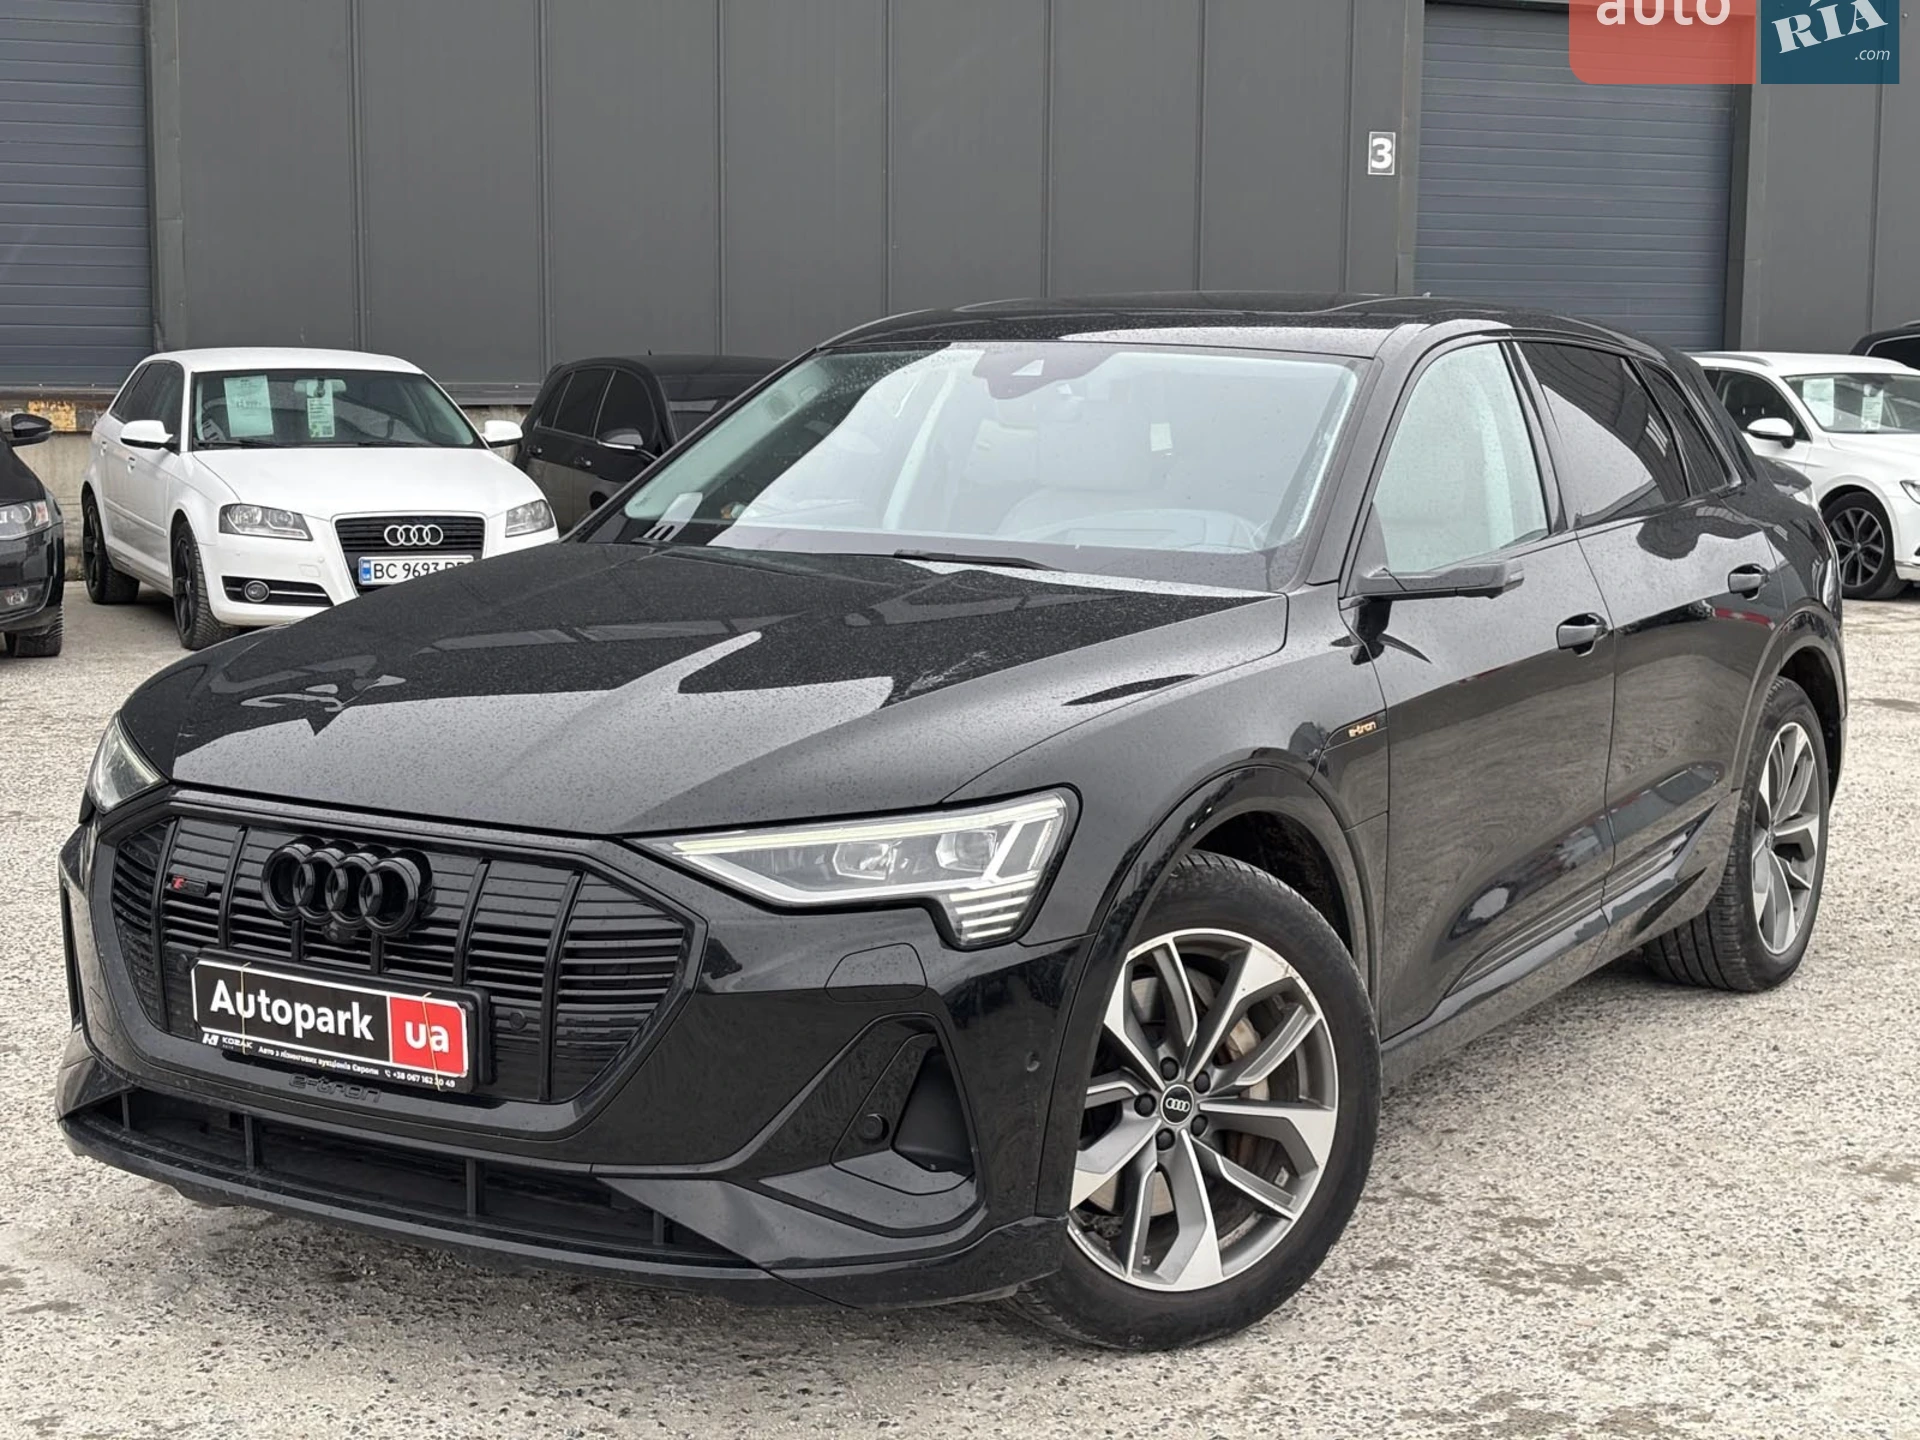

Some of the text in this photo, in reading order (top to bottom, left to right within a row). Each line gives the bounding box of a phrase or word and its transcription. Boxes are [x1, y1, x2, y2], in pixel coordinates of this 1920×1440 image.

[1371, 137, 1393, 169] 3
[373, 563, 398, 579] BC
[1348, 721, 1377, 738] e-tron
[210, 979, 450, 1054] Autopark ua
[289, 1073, 381, 1103] e-tron
